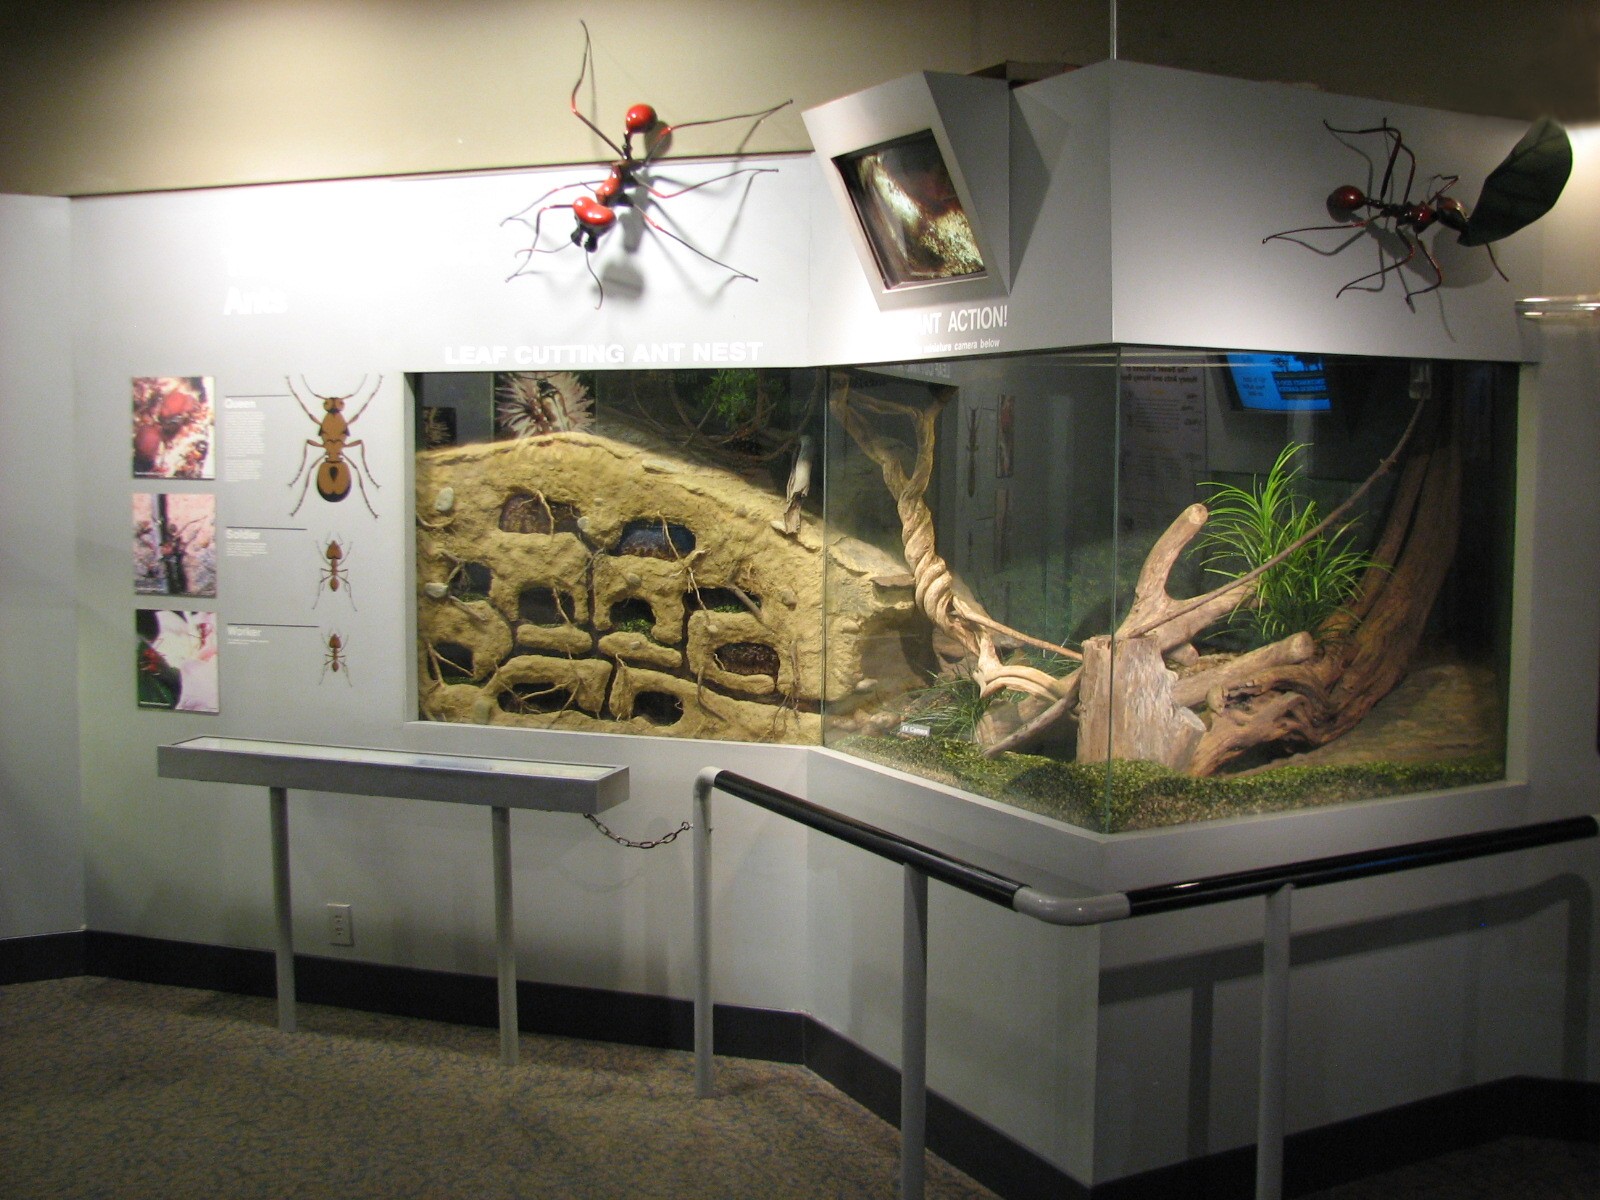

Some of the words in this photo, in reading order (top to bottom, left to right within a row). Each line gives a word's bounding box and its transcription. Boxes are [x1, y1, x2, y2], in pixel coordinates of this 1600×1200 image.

[224, 286, 288, 316] Ants
[947, 304, 1008, 332] ACTION!
[444, 345, 507, 366] LEAF
[515, 344, 625, 365] CUTTING
[632, 343, 686, 363] ANT
[692, 341, 764, 362] NEST
[954, 340, 978, 351] camera
[980, 338, 1001, 348] below
[227, 626, 262, 636] Worker
